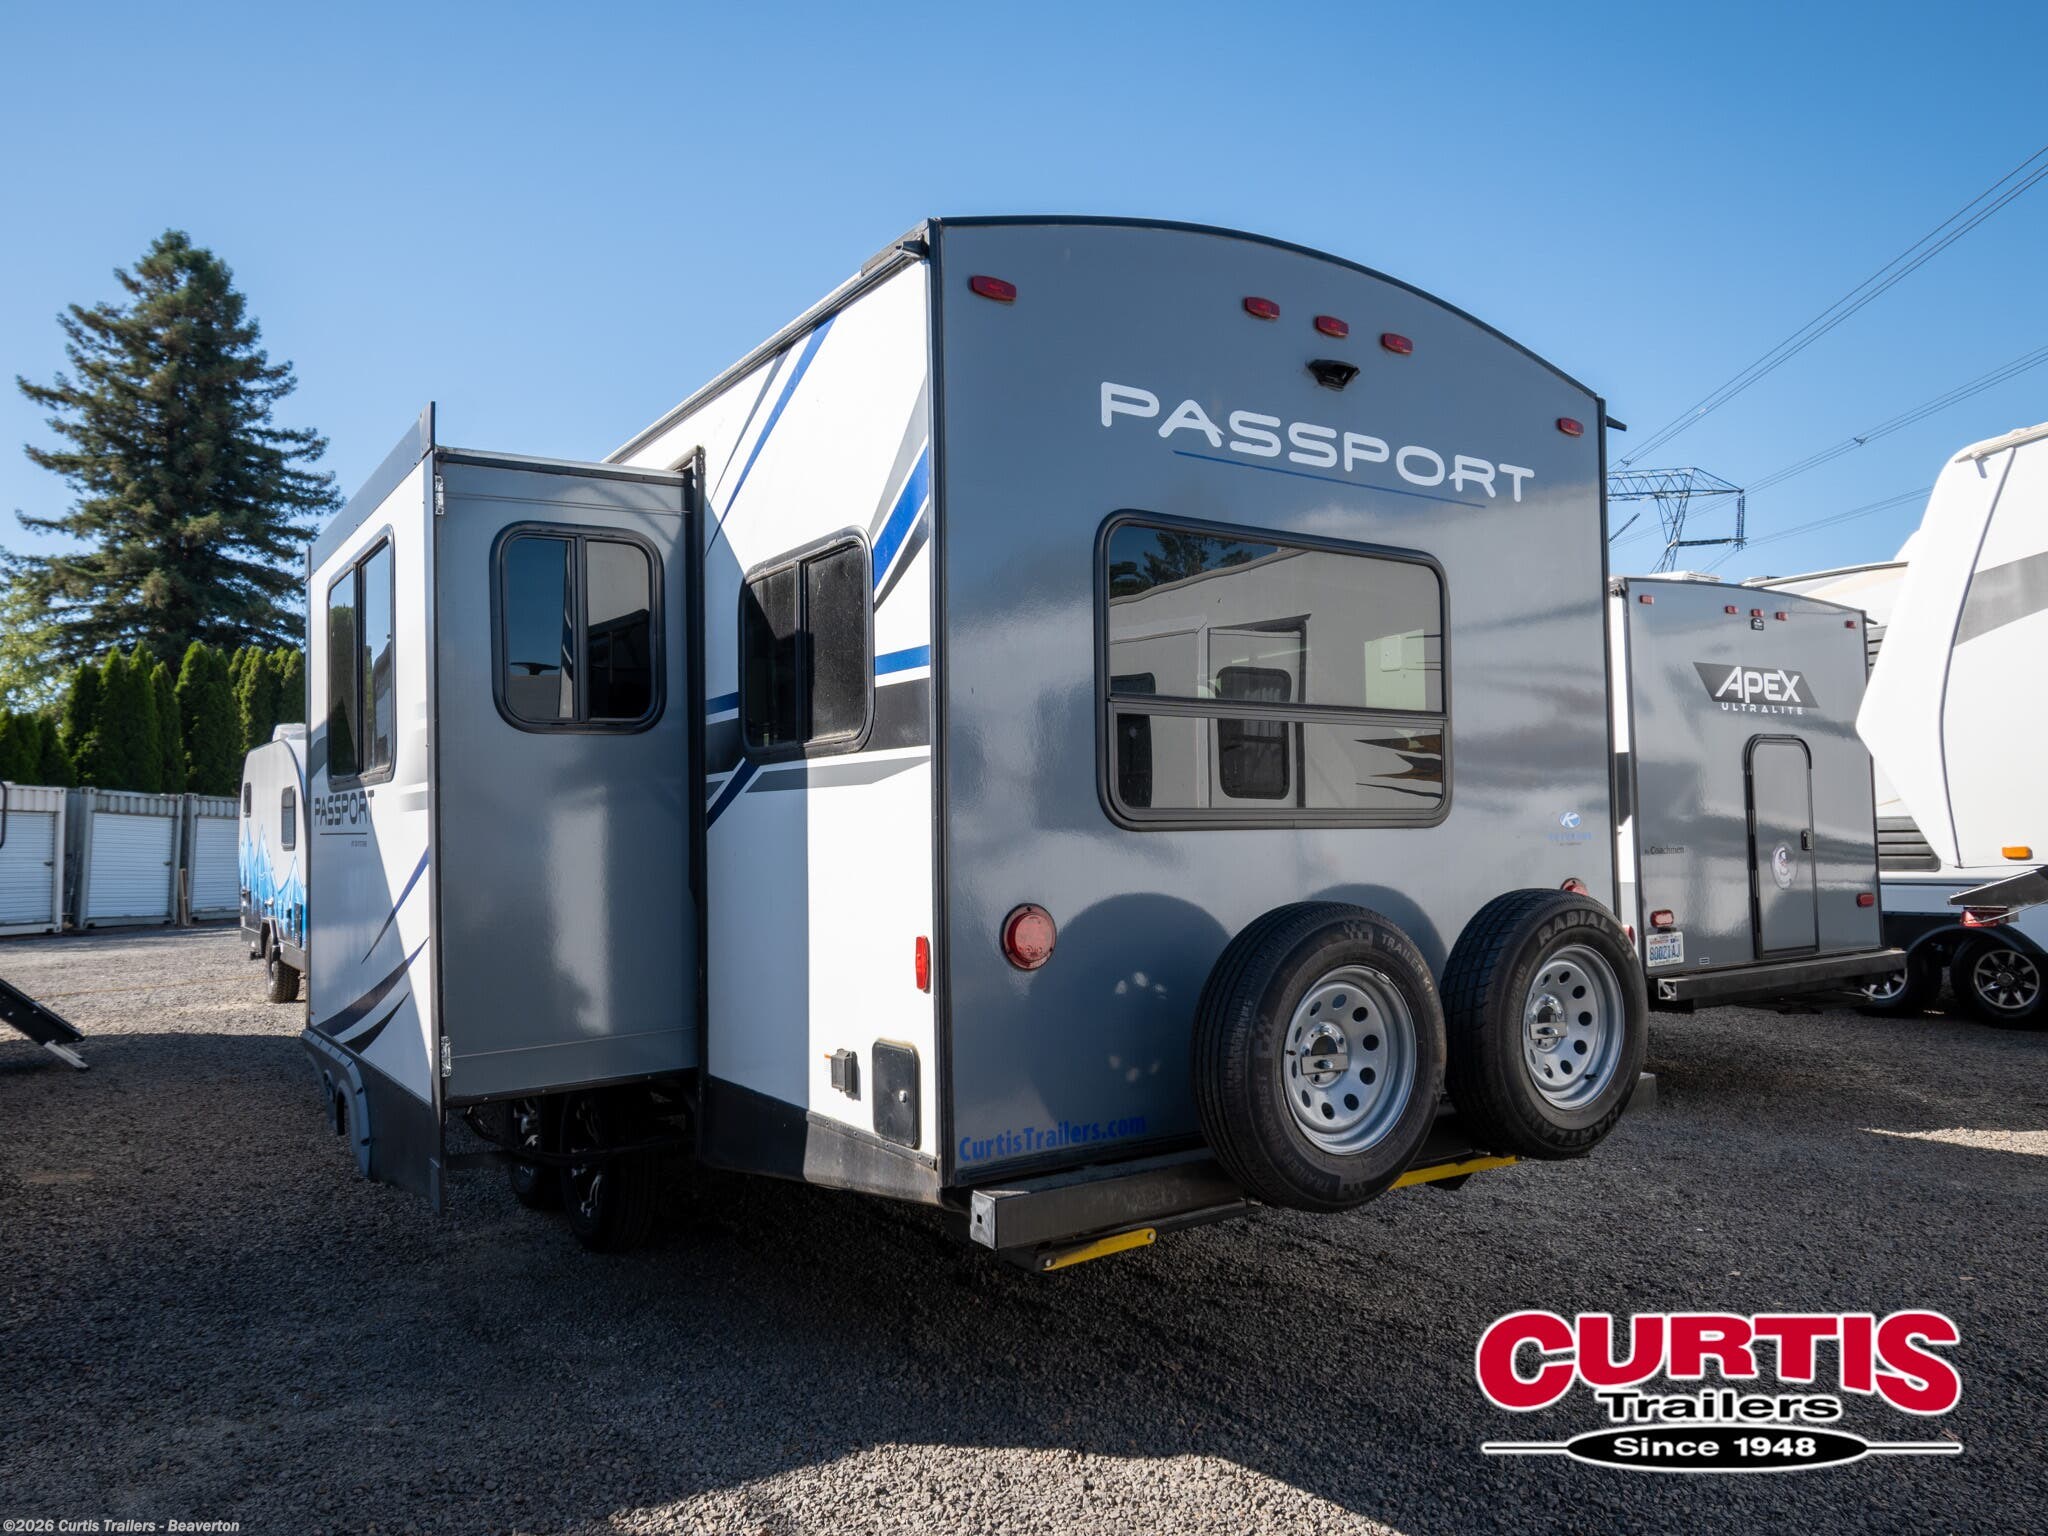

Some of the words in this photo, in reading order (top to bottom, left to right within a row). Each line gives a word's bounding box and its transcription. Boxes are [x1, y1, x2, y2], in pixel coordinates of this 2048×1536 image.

[1100, 381, 1535, 502] PASSPORT
[1715, 666, 1801, 703] APEX
[1721, 702, 1803, 715] ULTRALITE
[314, 790, 375, 826] PASSPORT
[1650, 846, 1685, 855] Coachmen
[1537, 911, 1611, 946] RADIAL
[1381, 932, 1424, 976] TRAILER
[959, 1116, 1148, 1162] CurtisTrailers.com
